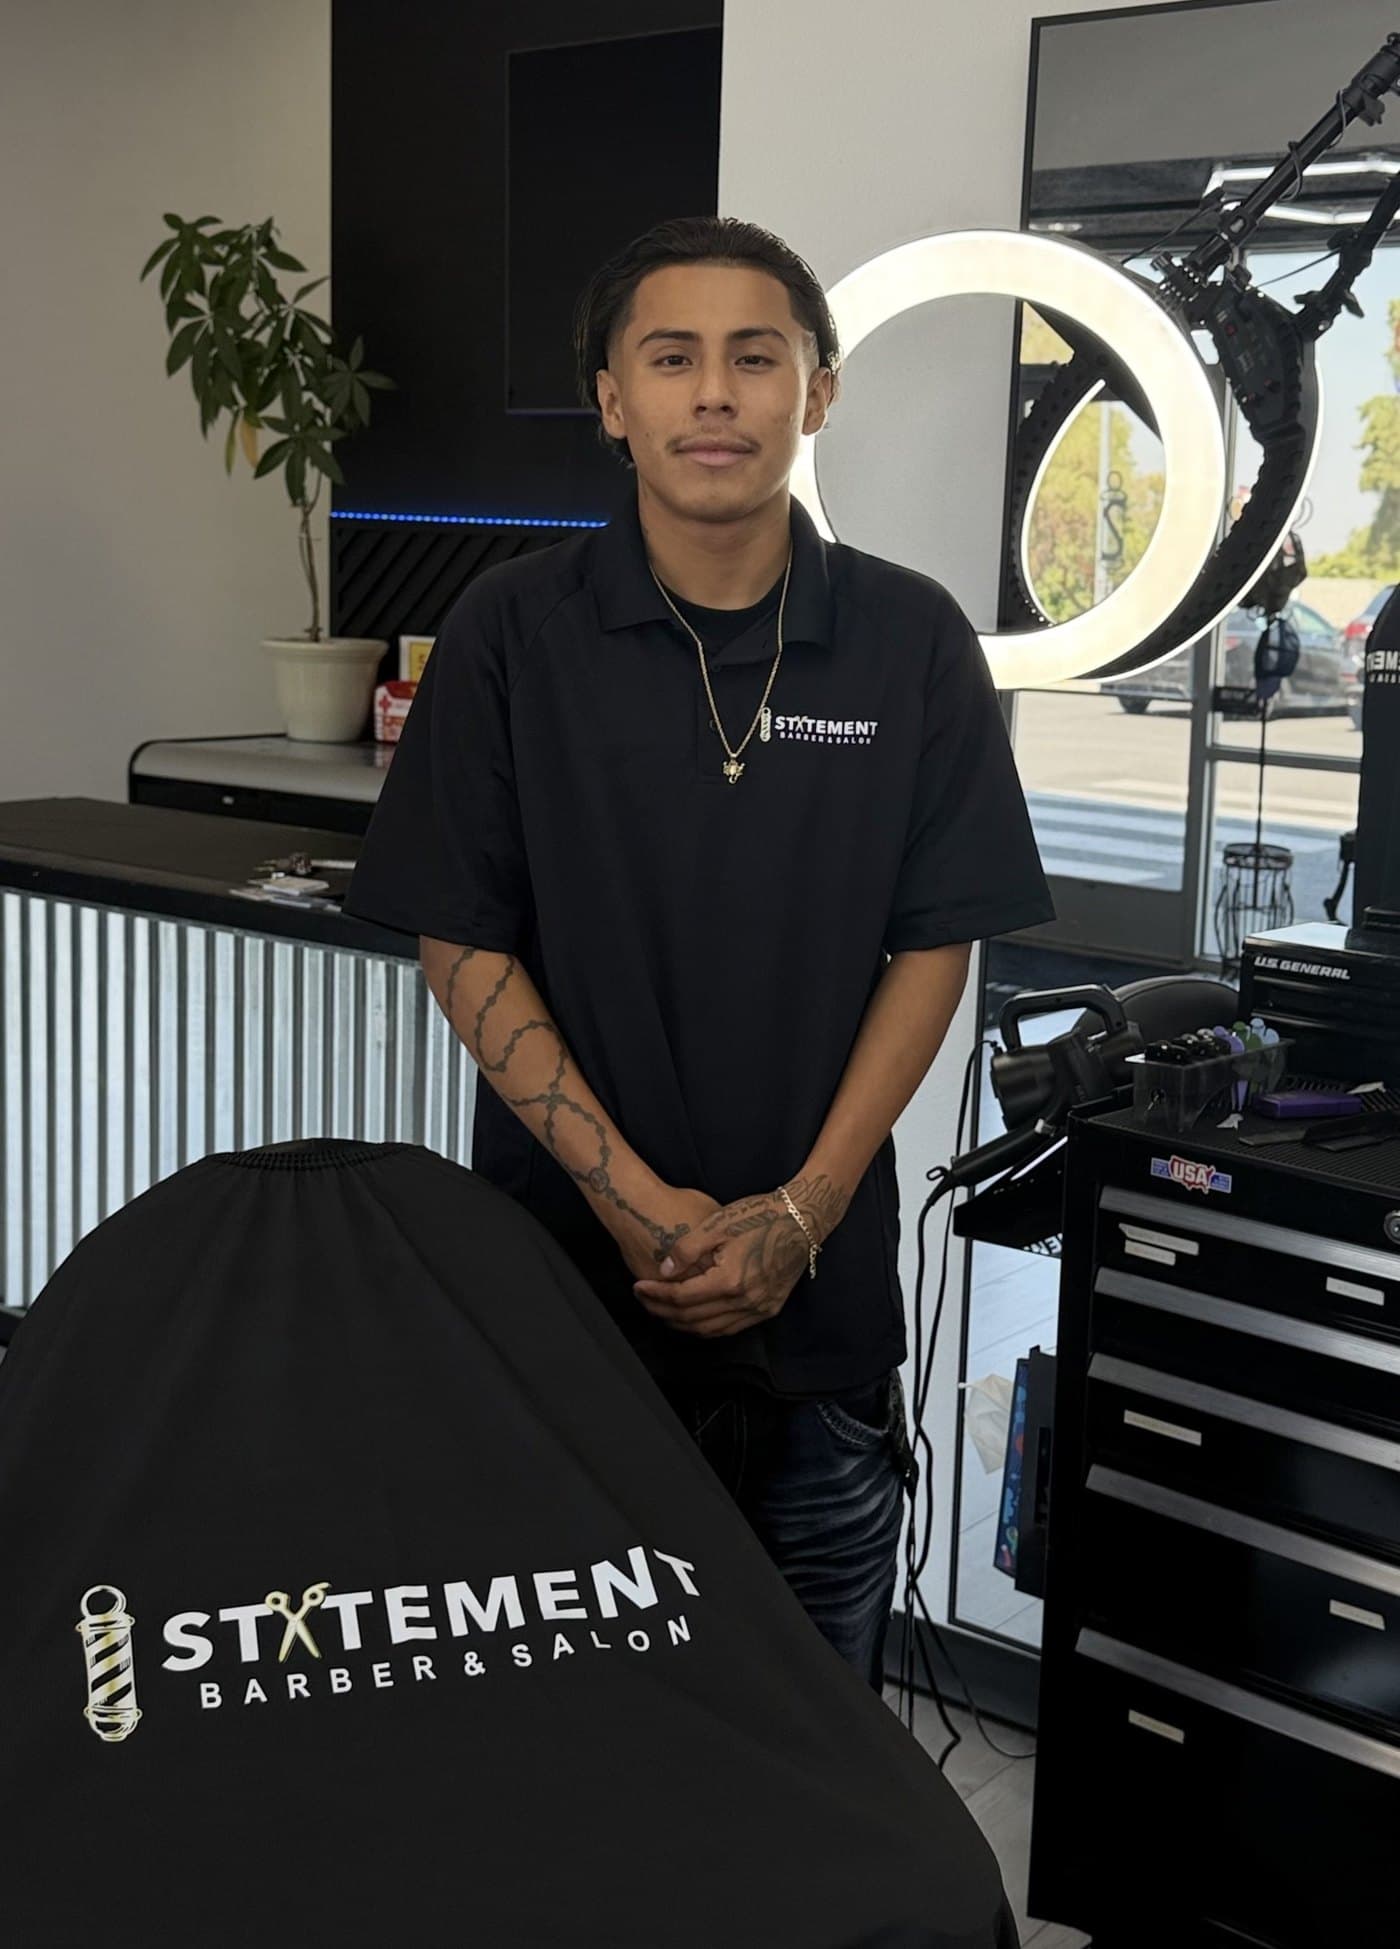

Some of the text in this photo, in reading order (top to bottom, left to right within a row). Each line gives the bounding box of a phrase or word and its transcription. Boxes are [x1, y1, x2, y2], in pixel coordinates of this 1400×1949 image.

[1280, 960, 1350, 980] GENERAL
[1173, 1161, 1208, 1185] USA
[200, 1615, 692, 1709] BARBER & SALON
